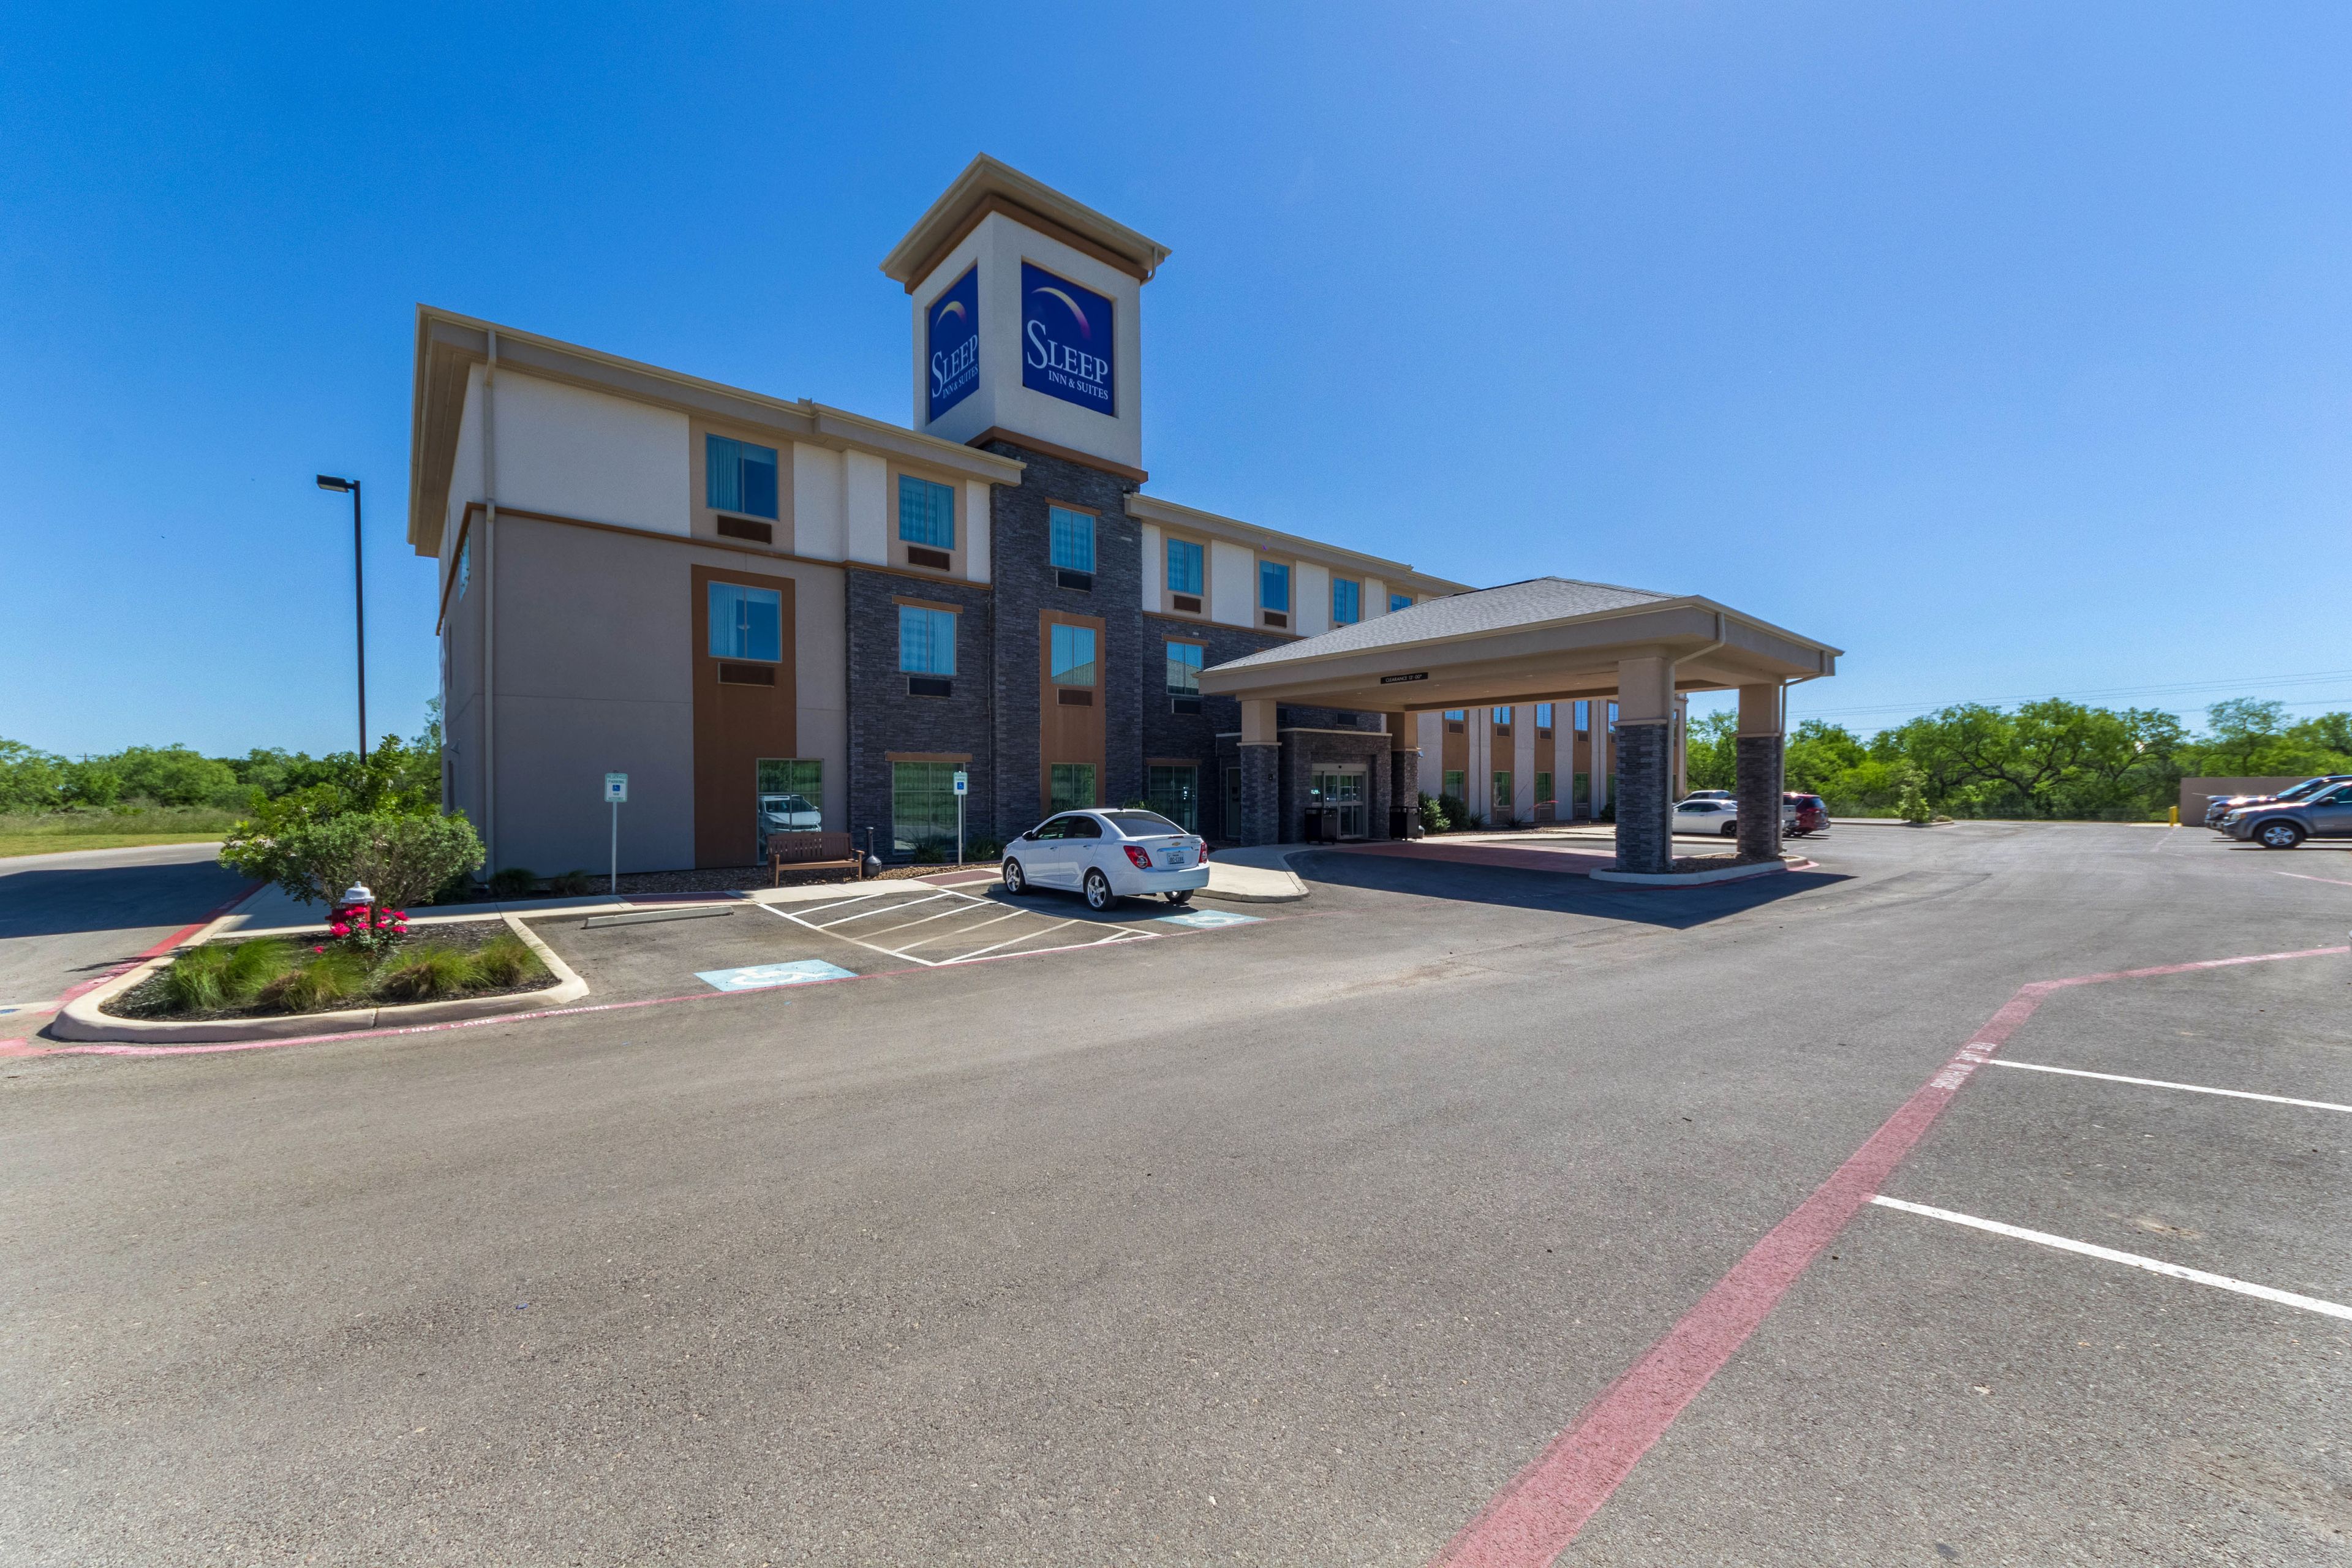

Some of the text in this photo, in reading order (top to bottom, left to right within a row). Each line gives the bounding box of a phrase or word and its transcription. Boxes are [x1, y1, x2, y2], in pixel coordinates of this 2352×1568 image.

[932, 334, 978, 399] SLEEP
[1027, 319, 1109, 384] SLEEP
[959, 363, 978, 387] SUITES
[1048, 370, 1109, 400] INN & SUITES
[450, 1018, 497, 1028] LANE
